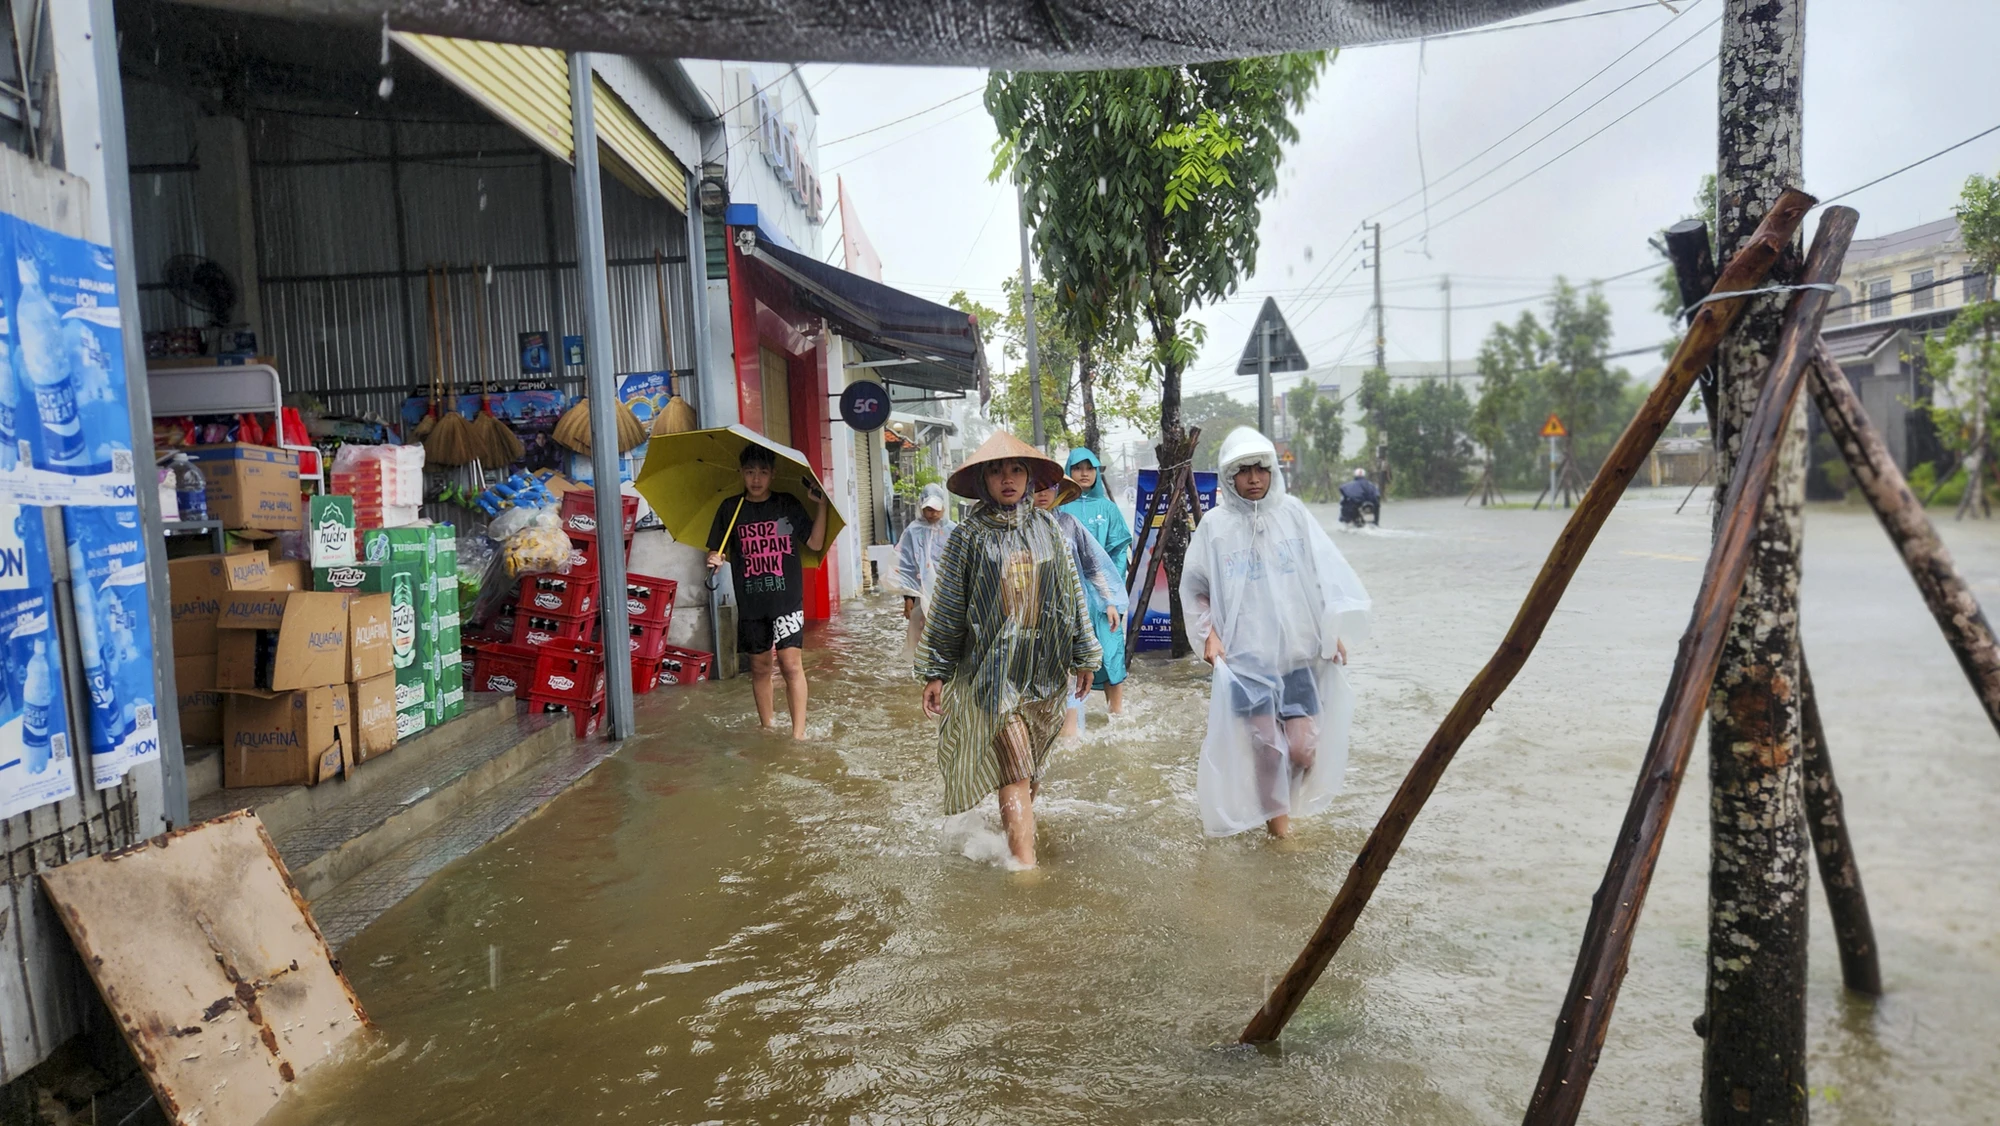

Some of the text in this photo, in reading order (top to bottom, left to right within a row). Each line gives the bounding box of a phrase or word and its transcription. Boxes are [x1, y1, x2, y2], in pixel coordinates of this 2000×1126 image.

[853, 398, 878, 414] 5G
[112, 485, 135, 499] ION
[320, 523, 347, 545] huda
[739, 522, 776, 539] DSQ2
[744, 536, 788, 555] JAPAN
[233, 561, 268, 583] AQUAFINA
[745, 555, 781, 575] PUNK
[327, 568, 365, 584] huda
[225, 601, 284, 618] AQUAFIN
[308, 631, 344, 649] AQUAFINA
[355, 621, 391, 648] AQUAFINA
[361, 700, 394, 729] AQUAFINA
[134, 738, 157, 757] ION
[234, 731, 300, 751] AQUAFINA
